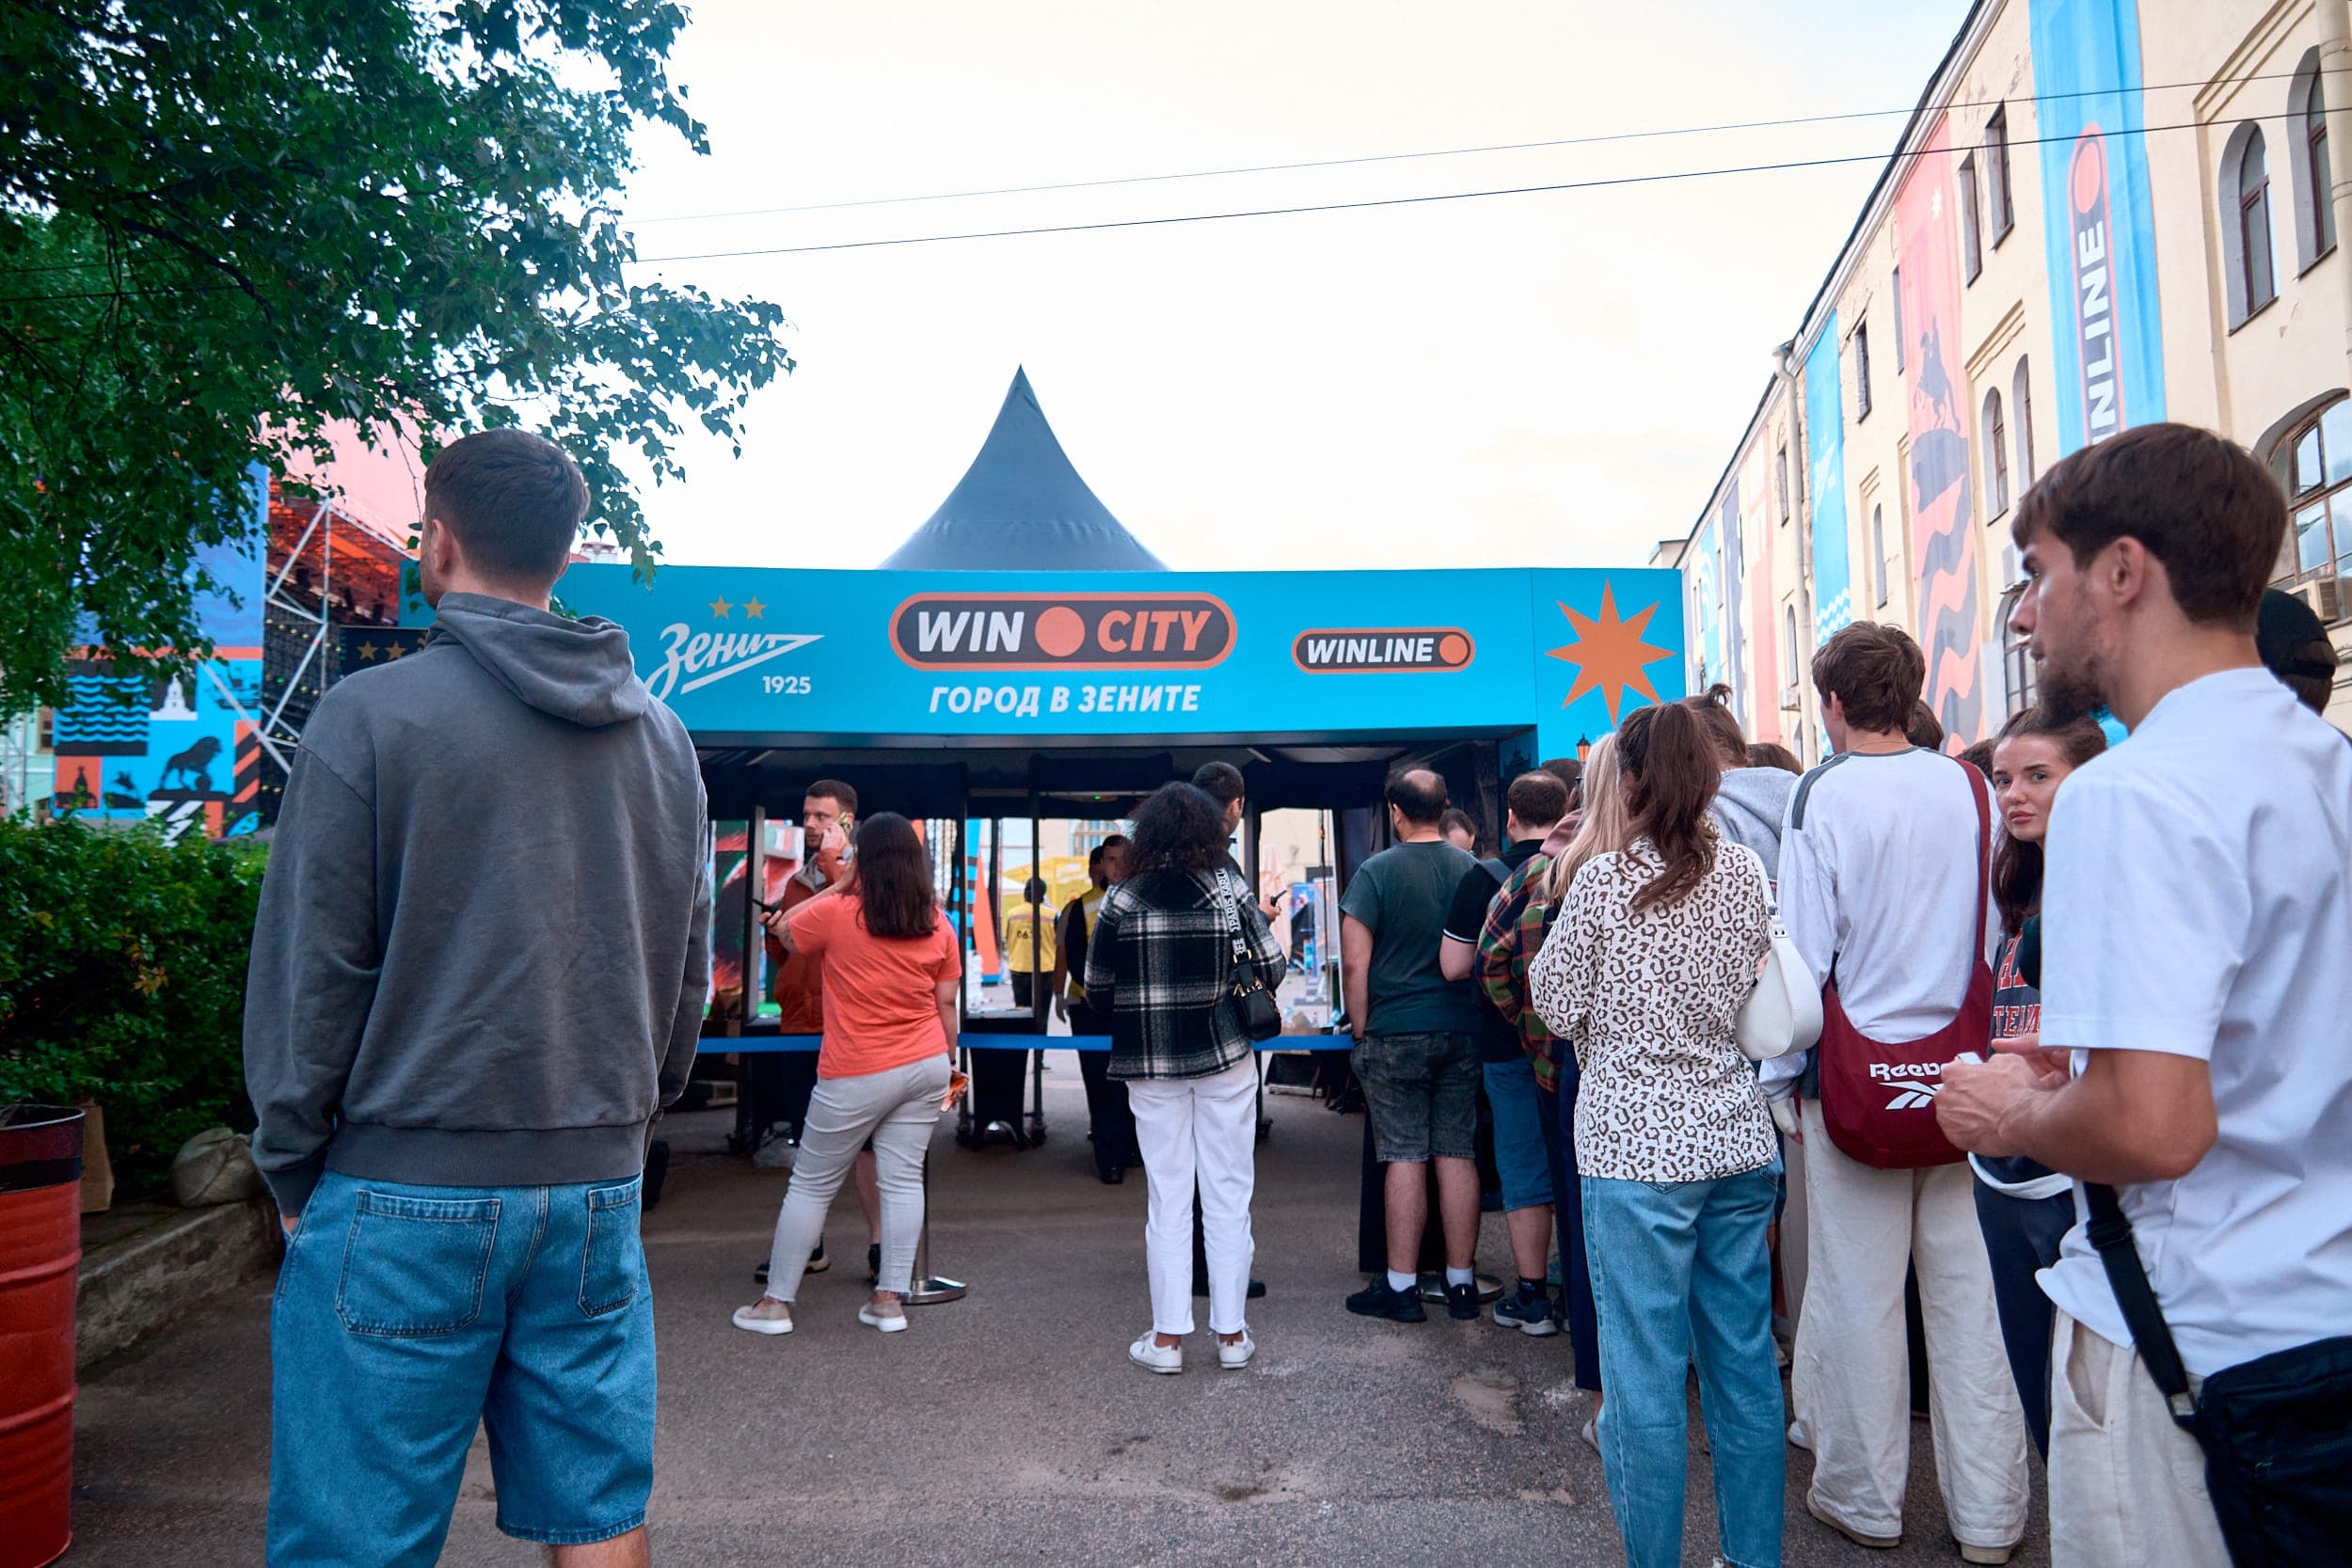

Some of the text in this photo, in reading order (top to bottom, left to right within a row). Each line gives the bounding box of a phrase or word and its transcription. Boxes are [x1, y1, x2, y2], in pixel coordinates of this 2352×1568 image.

[2079, 220, 2117, 445] NLINE
[918, 610, 1212, 653] WIN CITY
[1308, 638, 1435, 664] WINLINE
[762, 675, 812, 695] 1925
[929, 685, 1202, 718] ГОРОД В ЗЕНИТЕ
[1869, 1062, 1949, 1081] Reeb
